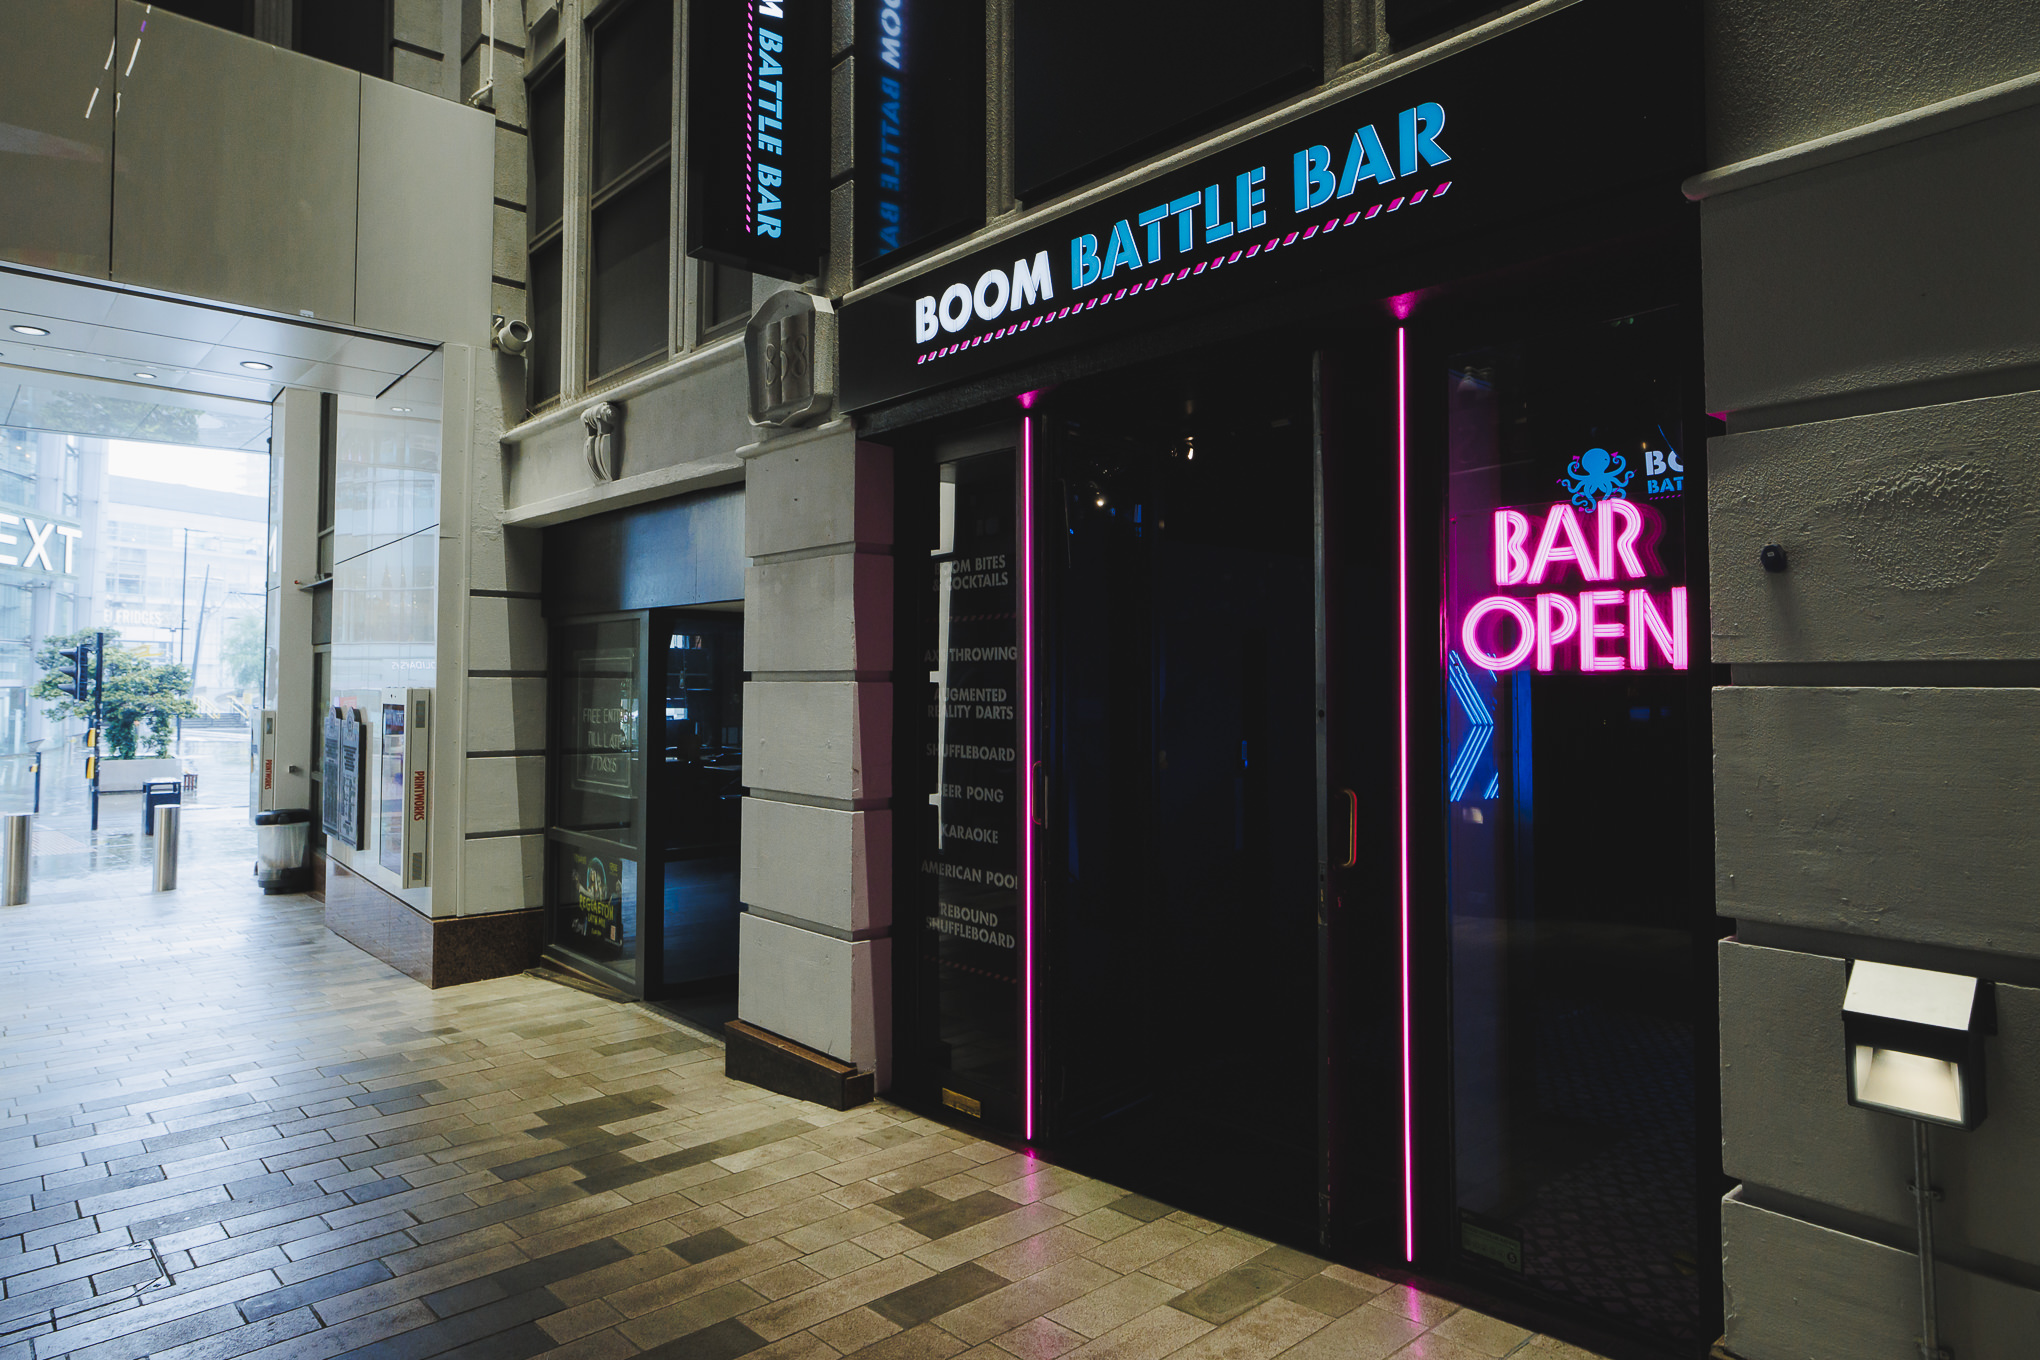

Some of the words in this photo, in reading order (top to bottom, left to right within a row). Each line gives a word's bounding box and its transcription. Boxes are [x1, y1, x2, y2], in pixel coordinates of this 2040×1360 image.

[758, 27, 783, 156] BATTLE
[757, 163, 782, 239] BAR
[915, 250, 1054, 344] BOOM
[1070, 166, 1267, 291] BATTLE
[1293, 102, 1452, 214] BAR
[1647, 476, 1684, 494] BAT
[1494, 498, 1647, 586] BAR
[975, 554, 1006, 572] BITES
[1461, 586, 1689, 672] OPEN
[949, 646, 1017, 662] THROWING
[975, 705, 1014, 720] DARTS
[596, 755, 617, 773] DAYS
[414, 770, 425, 821] PRINTWORKS
[936, 783, 962, 799] EER
[966, 785, 1004, 804] PONG
[921, 859, 982, 883] AMERICAN
[939, 902, 999, 928] REBOUND
[926, 916, 1016, 950] SHUFFLEBOARD
